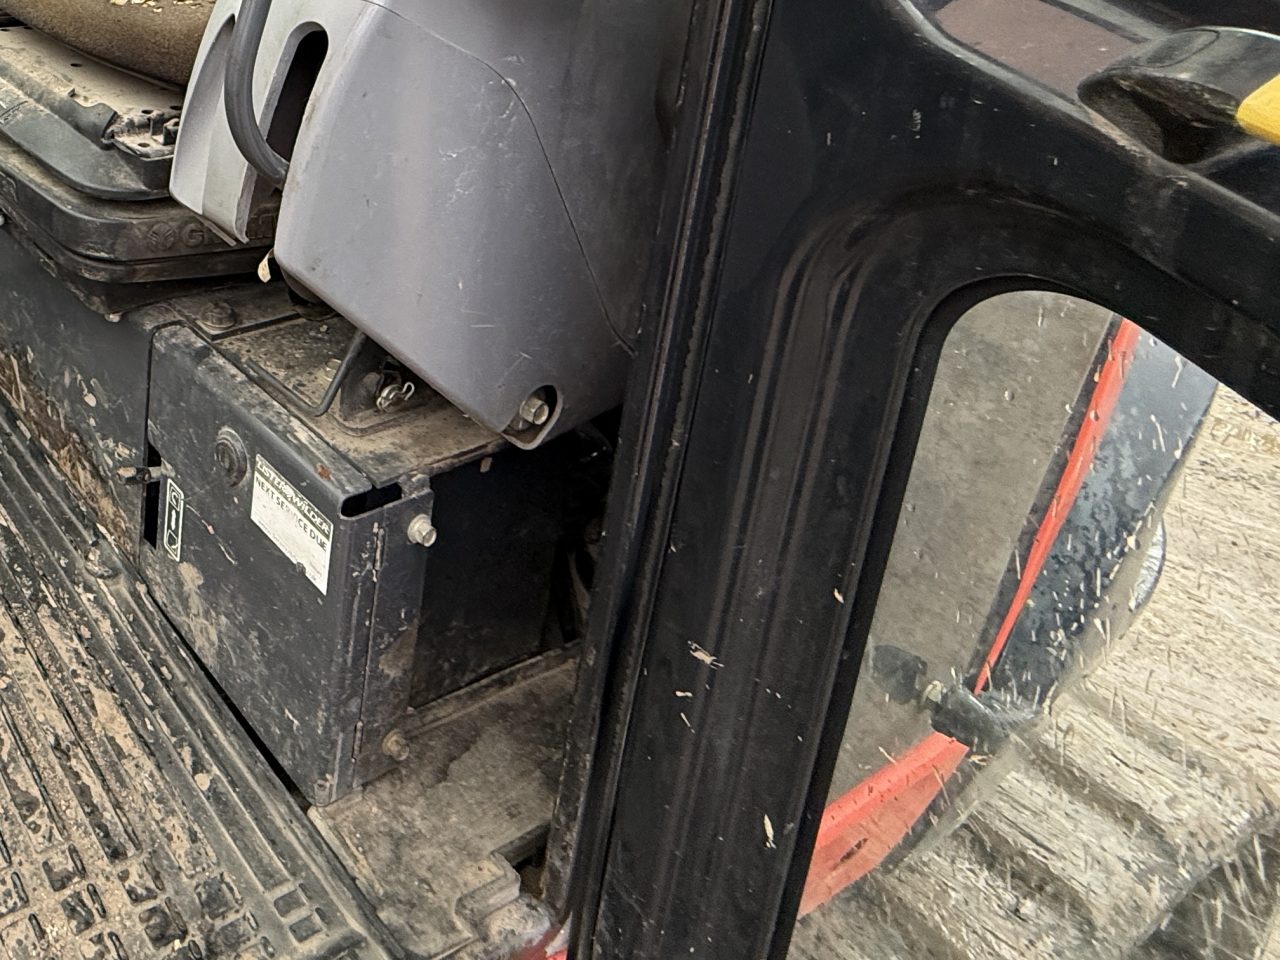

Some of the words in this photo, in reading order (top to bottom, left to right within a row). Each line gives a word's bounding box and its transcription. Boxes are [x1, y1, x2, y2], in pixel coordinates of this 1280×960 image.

[255, 476, 275, 501] NEXT
[276, 496, 308, 533] SERICE
[309, 529, 327, 553] DUE
